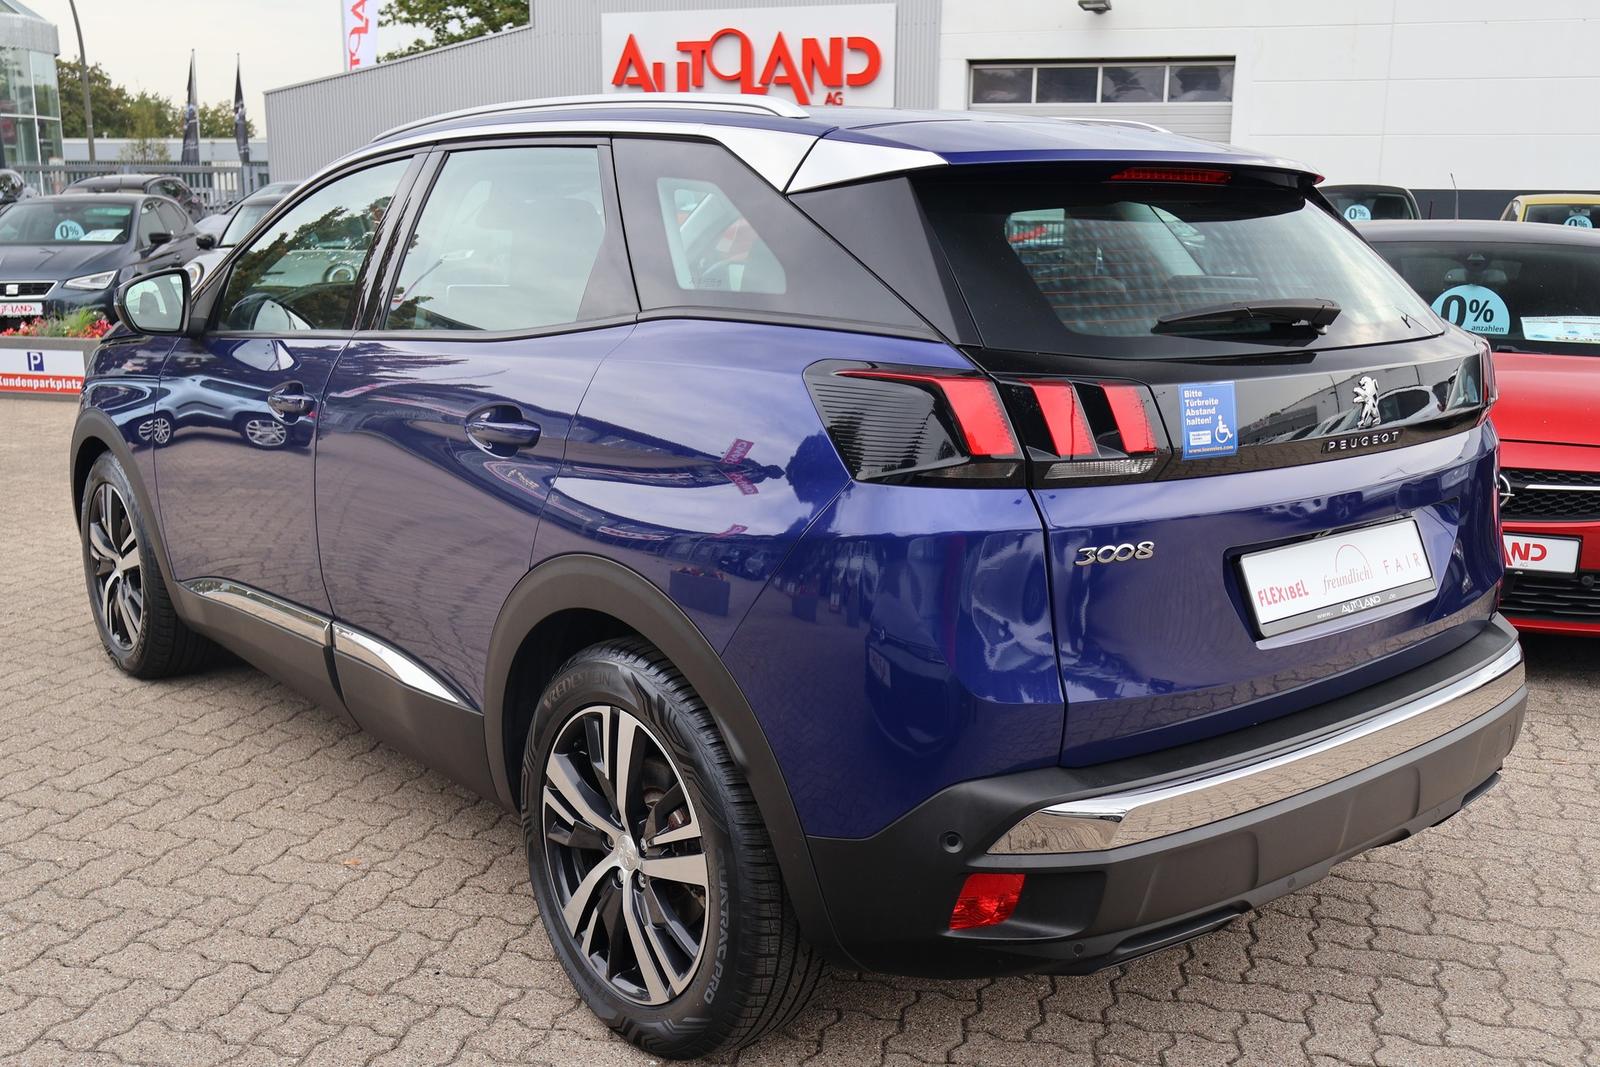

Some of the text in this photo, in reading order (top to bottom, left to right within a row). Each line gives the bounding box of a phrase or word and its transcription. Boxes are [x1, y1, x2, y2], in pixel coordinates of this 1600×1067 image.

[824, 91, 844, 105] AG
[1349, 207, 1367, 219] 0%
[60, 224, 79, 239] 0%
[1441, 294, 1494, 326] 0%
[1471, 324, 1505, 333] anzahlen
[1184, 389, 1203, 398] Bitte
[1185, 397, 1219, 407] Türbreite
[1186, 406, 1216, 416] Abstand
[1186, 416, 1212, 426] halten!
[1328, 431, 1399, 452] PEUGEOT
[1074, 541, 1155, 566] 3008
[1257, 580, 1310, 608] FLEXIBEL
[1382, 552, 1421, 576] FAIR
[1341, 595, 1381, 613] AUTOLAND
[703, 961, 724, 1005] PRO
